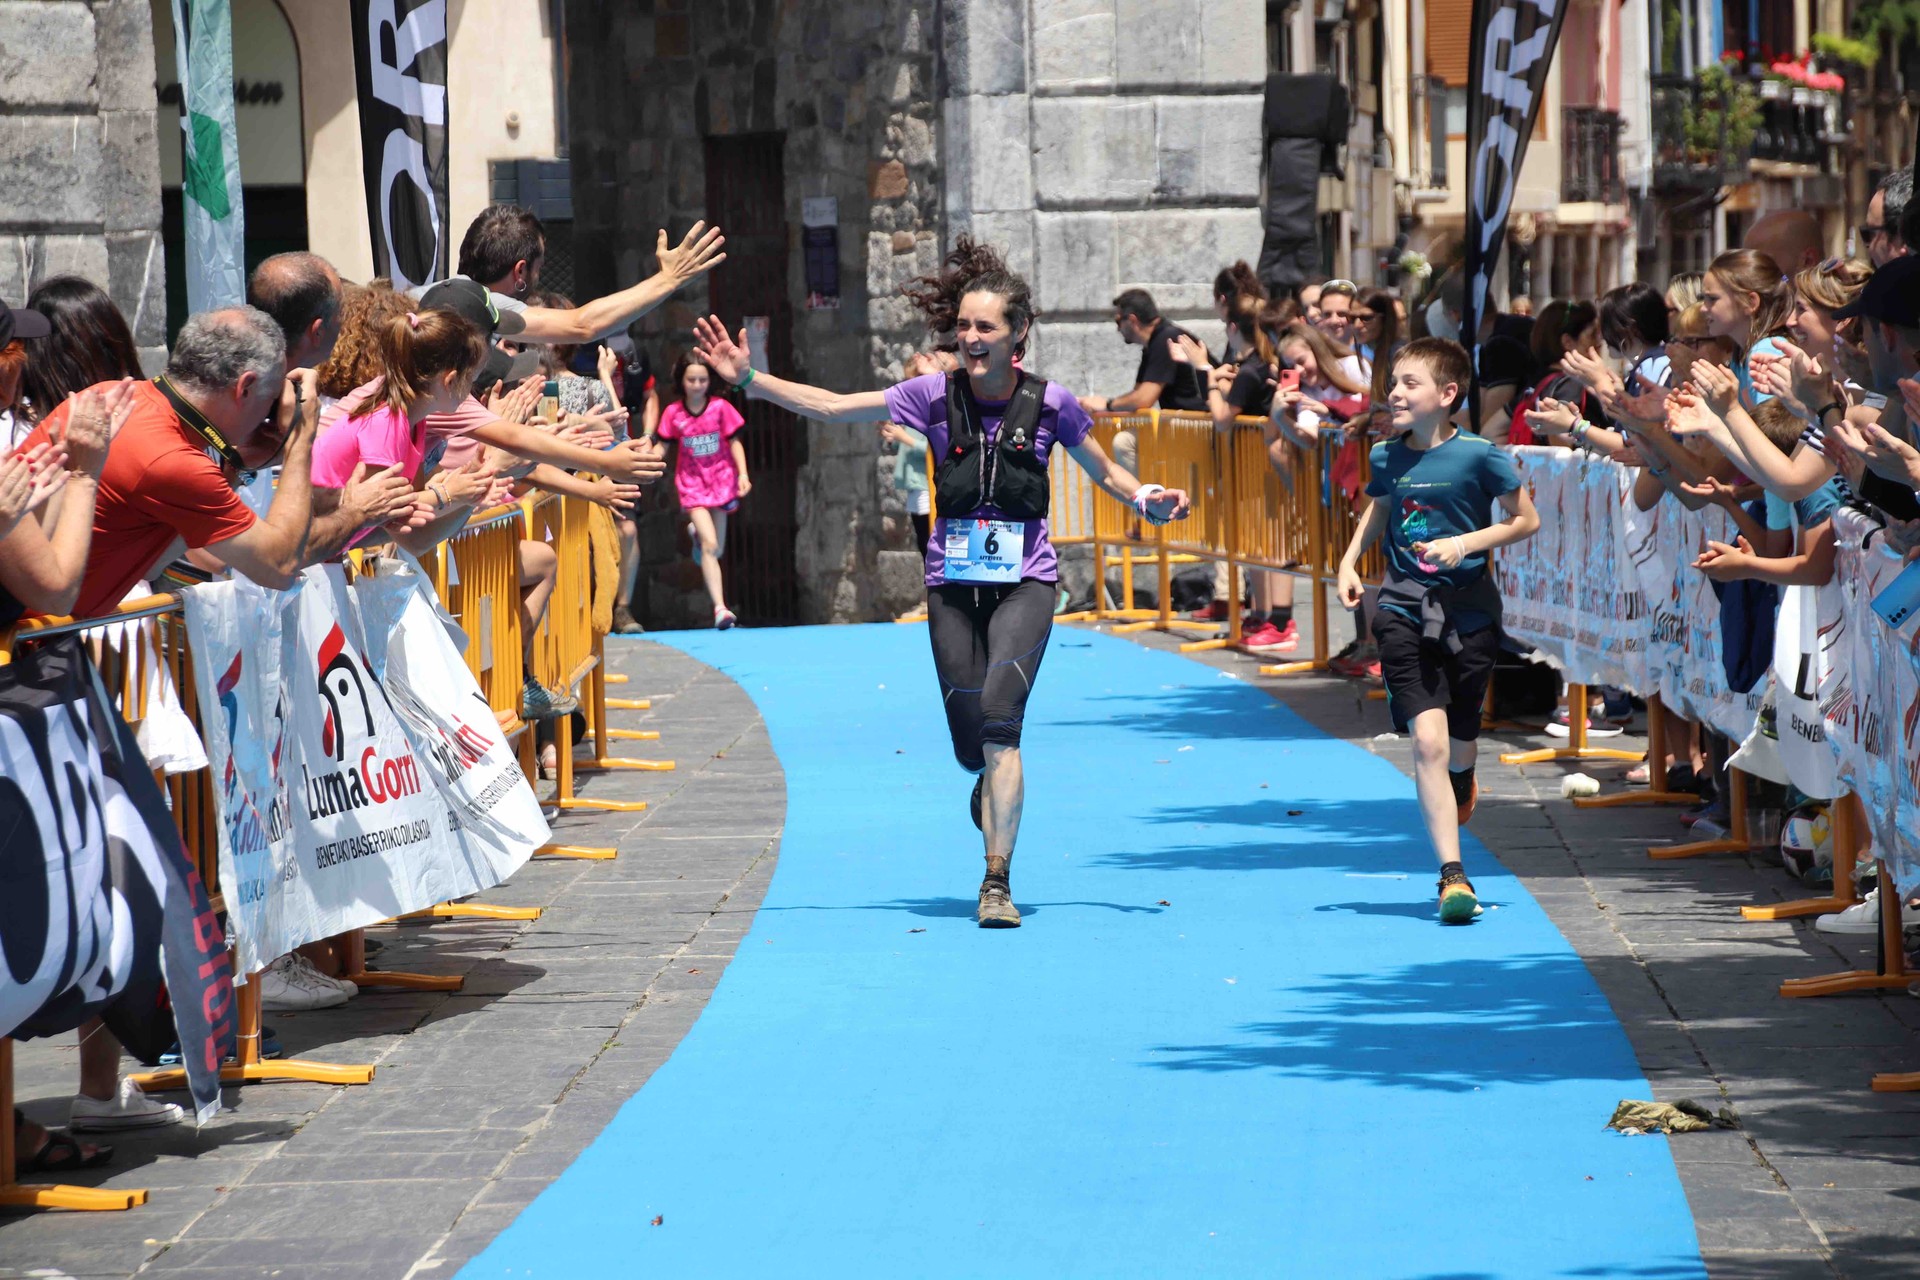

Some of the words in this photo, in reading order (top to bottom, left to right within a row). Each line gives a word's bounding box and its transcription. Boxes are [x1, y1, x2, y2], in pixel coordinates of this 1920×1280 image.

[204, 426, 227, 450] Nikon
[984, 531, 999, 555] 6
[302, 738, 422, 820] LumaGorri
[349, 826, 402, 859] BASERRIKO
